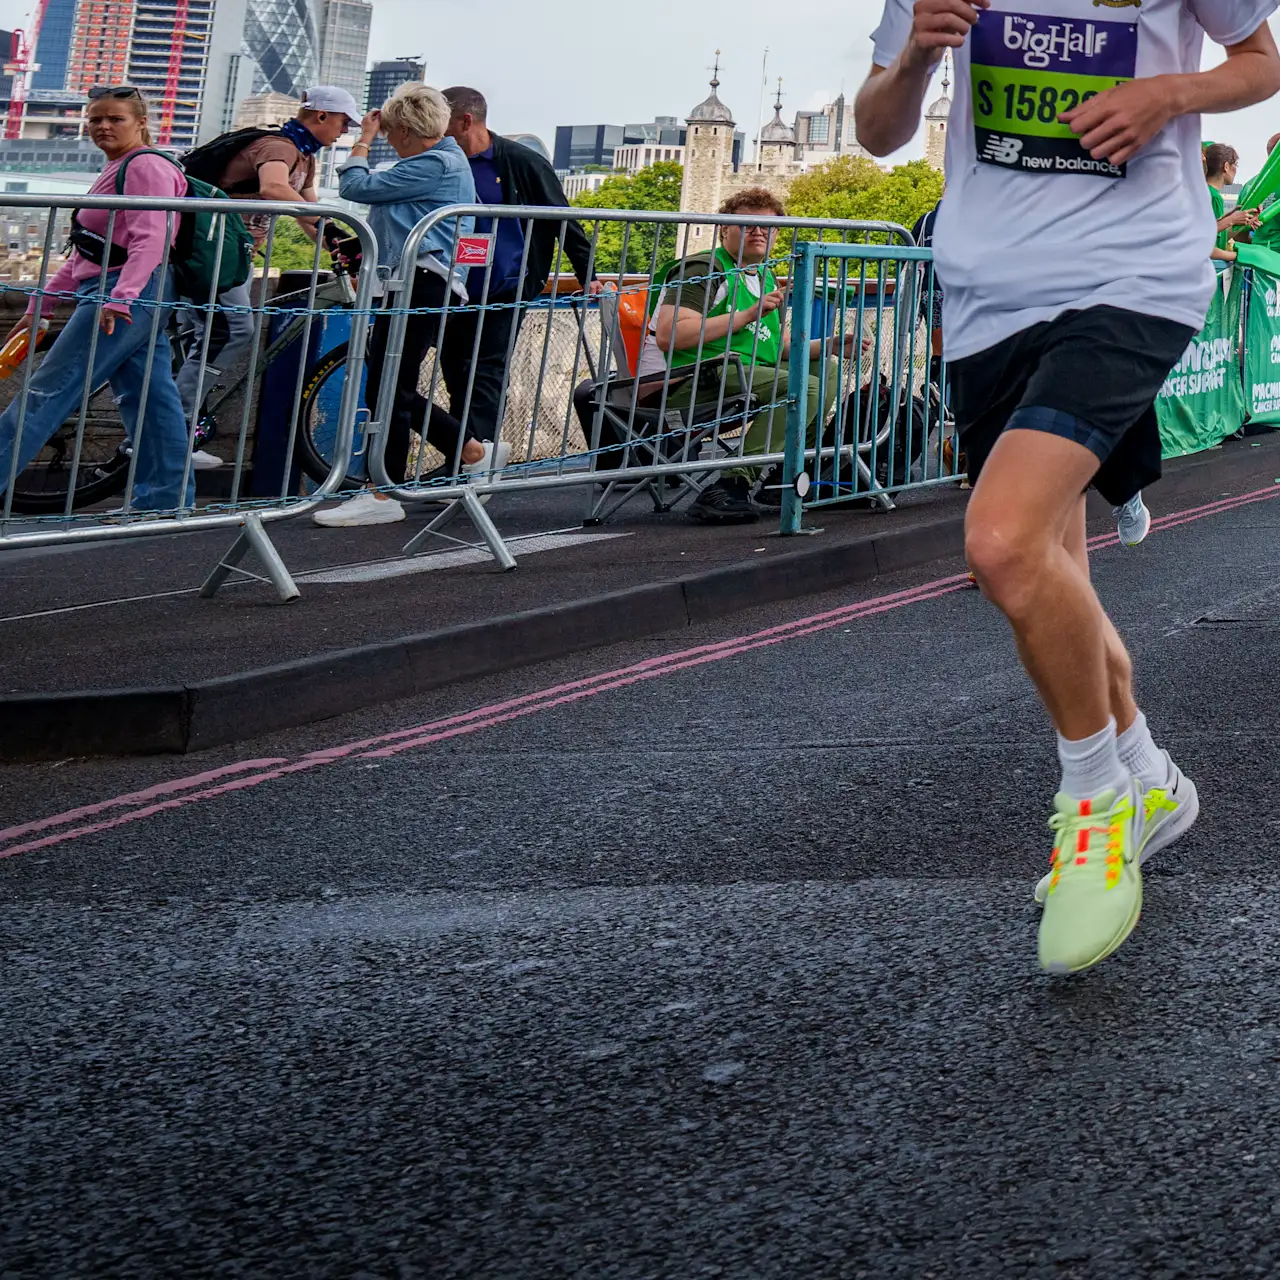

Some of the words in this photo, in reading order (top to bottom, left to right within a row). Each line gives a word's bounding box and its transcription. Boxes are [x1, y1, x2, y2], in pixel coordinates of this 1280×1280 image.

[1013, 16, 1027, 24] The
[978, 80, 993, 116] S
[982, 134, 1023, 164] NB
[1022, 156, 1053, 169] new
[1055, 156, 1119, 173] balance
[303, 360, 334, 399] MAXXIS
[1253, 399, 1272, 413] CANCER
